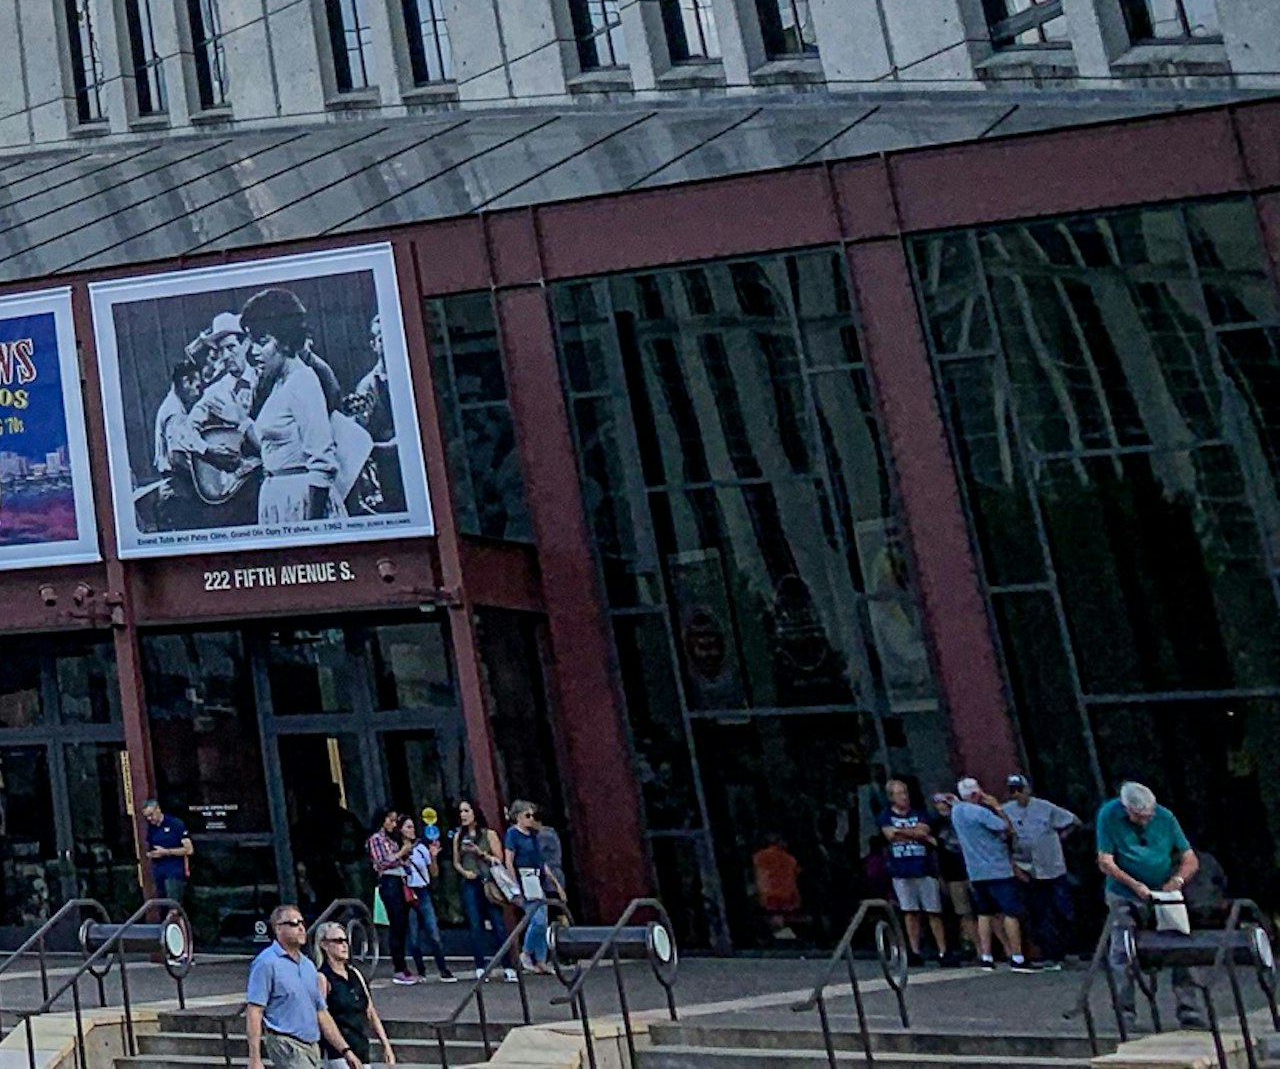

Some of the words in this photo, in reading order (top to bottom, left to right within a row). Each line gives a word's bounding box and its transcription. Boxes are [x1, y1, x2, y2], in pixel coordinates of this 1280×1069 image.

[204, 571, 231, 591] 222
[234, 567, 277, 588] FIFTH
[280, 562, 337, 586] AVENUE
[340, 561, 355, 581] S.
